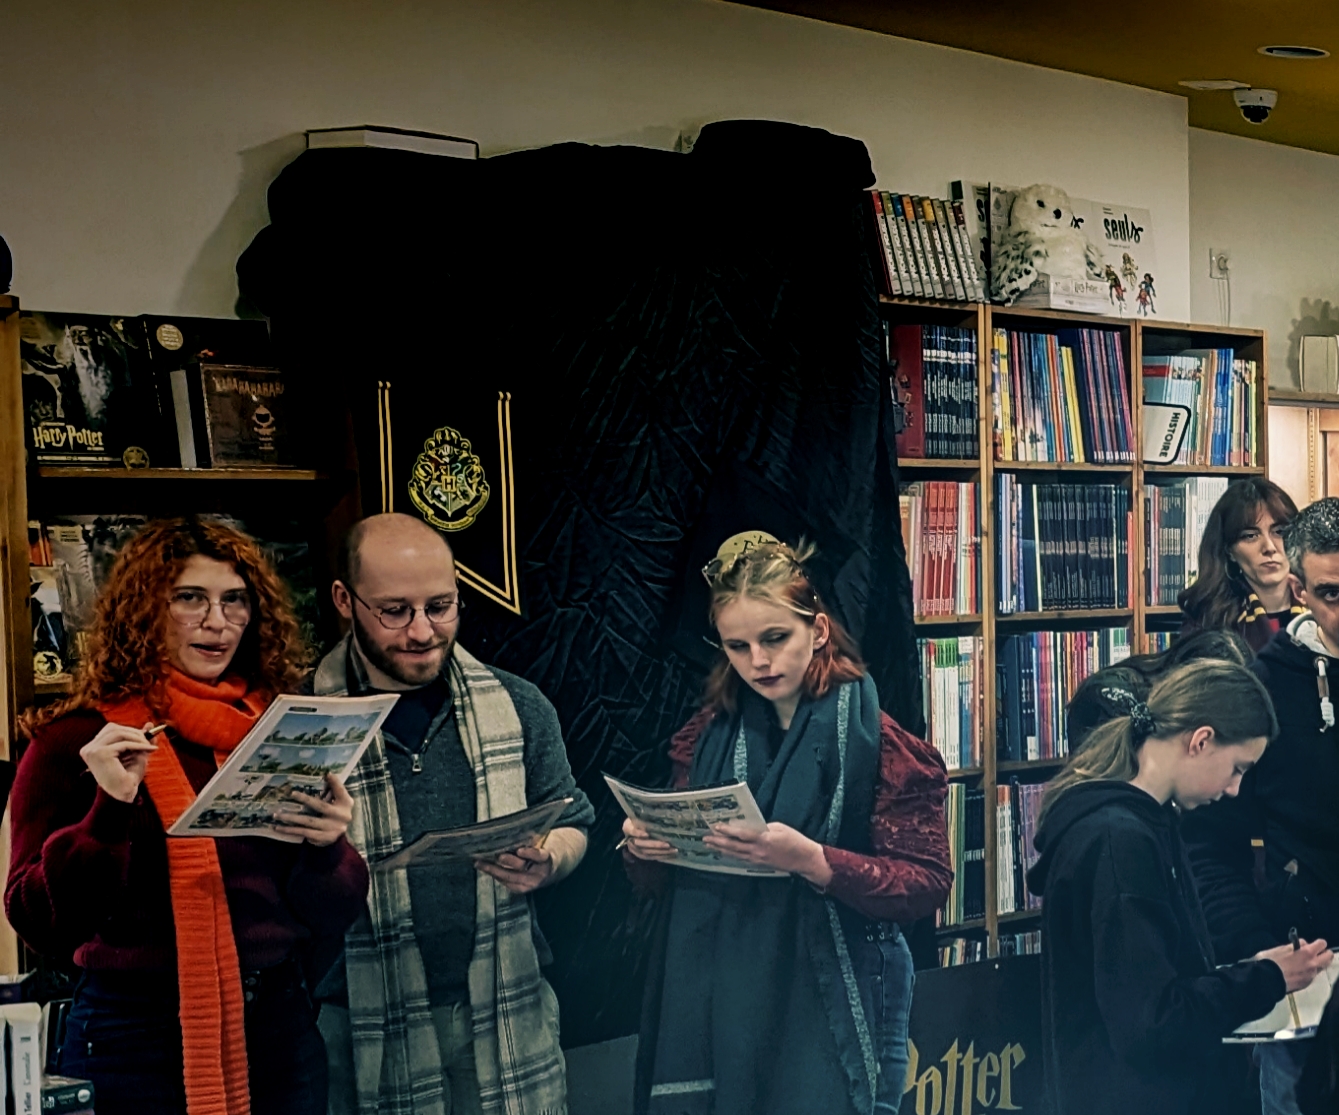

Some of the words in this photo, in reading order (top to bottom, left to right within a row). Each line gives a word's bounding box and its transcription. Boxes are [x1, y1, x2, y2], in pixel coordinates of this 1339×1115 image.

[32, 426, 67, 450] Harry
[68, 424, 104, 451] Potter
[1159, 412, 1181, 457] HISTOIRE
